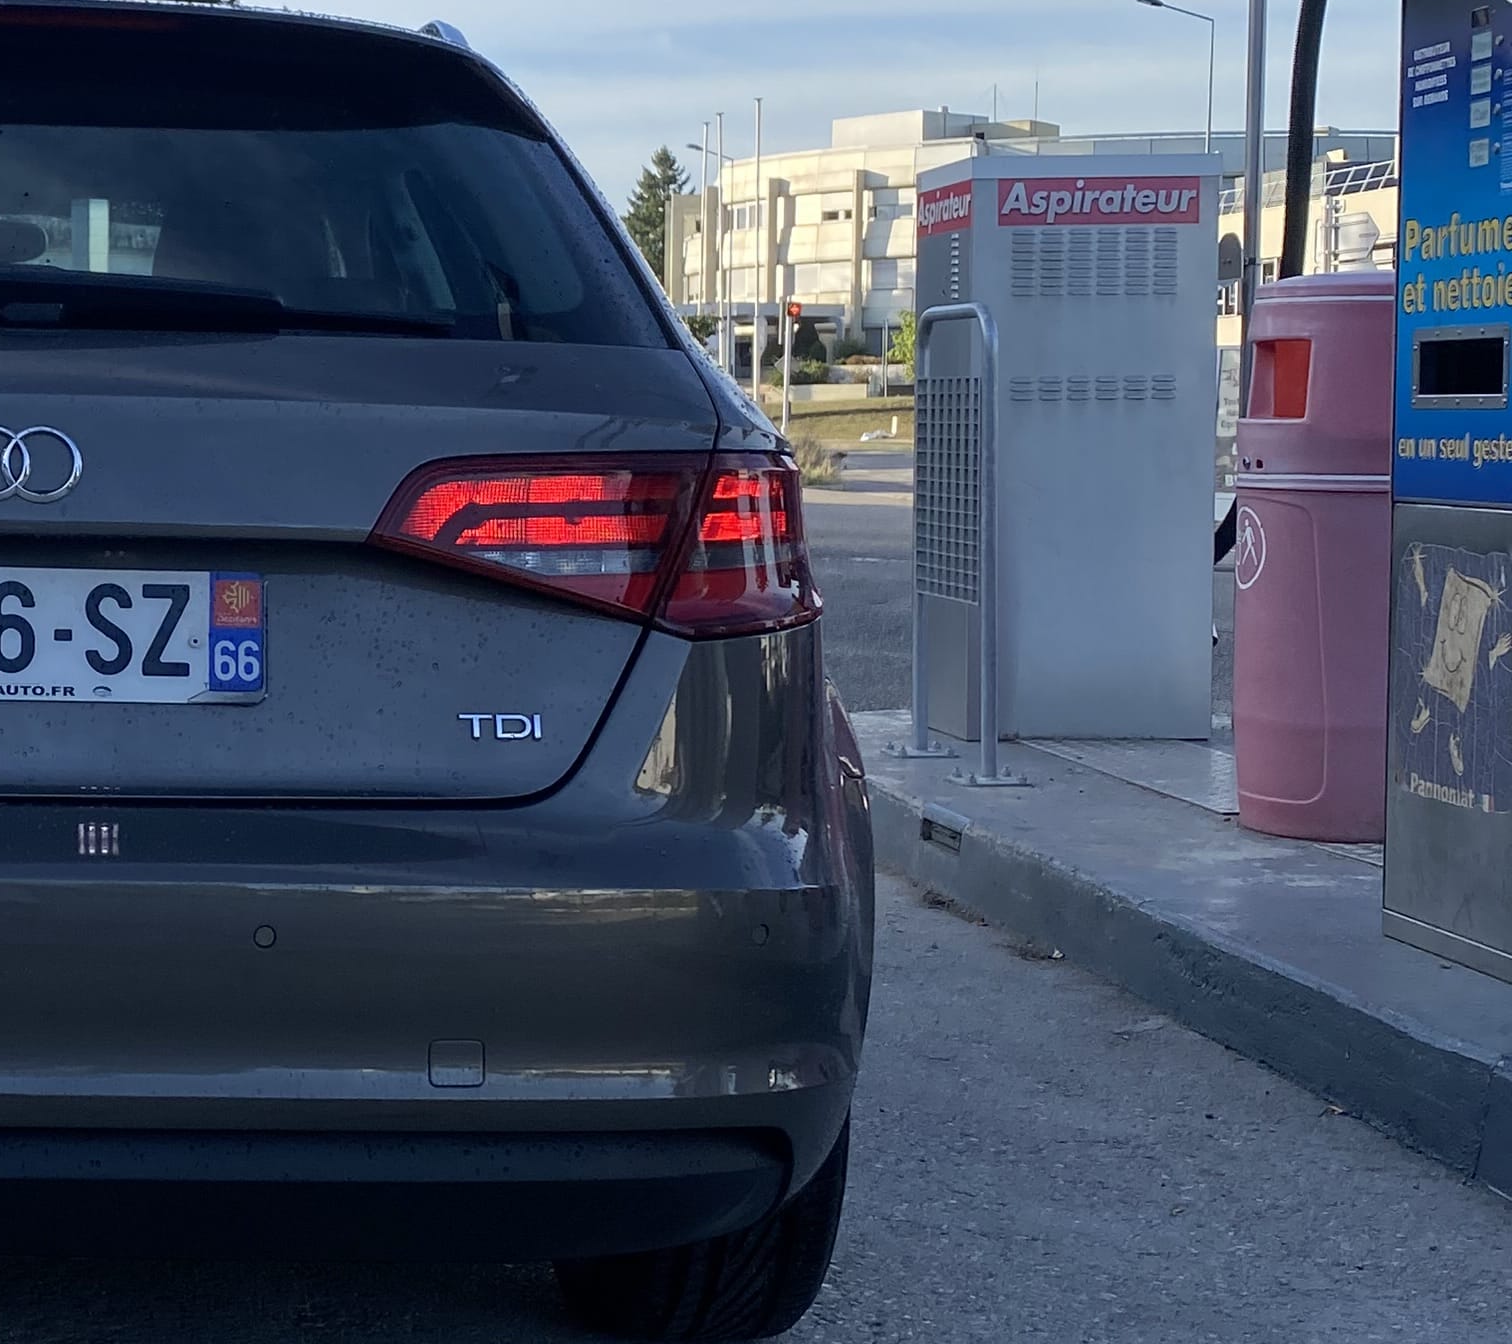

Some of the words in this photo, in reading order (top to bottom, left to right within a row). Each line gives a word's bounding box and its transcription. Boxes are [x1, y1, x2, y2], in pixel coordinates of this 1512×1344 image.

[918, 190, 971, 234] Aspirateur
[1001, 179, 1200, 224] Aspirateur
[1405, 212, 1512, 262] Parfume
[1403, 272, 1426, 314] et
[1398, 438, 1416, 459] en
[1418, 438, 1437, 460] un
[1439, 431, 1470, 461] seul
[1472, 432, 1512, 469] geste
[214, 639, 260, 682] 66
[458, 713, 543, 739] TDI
